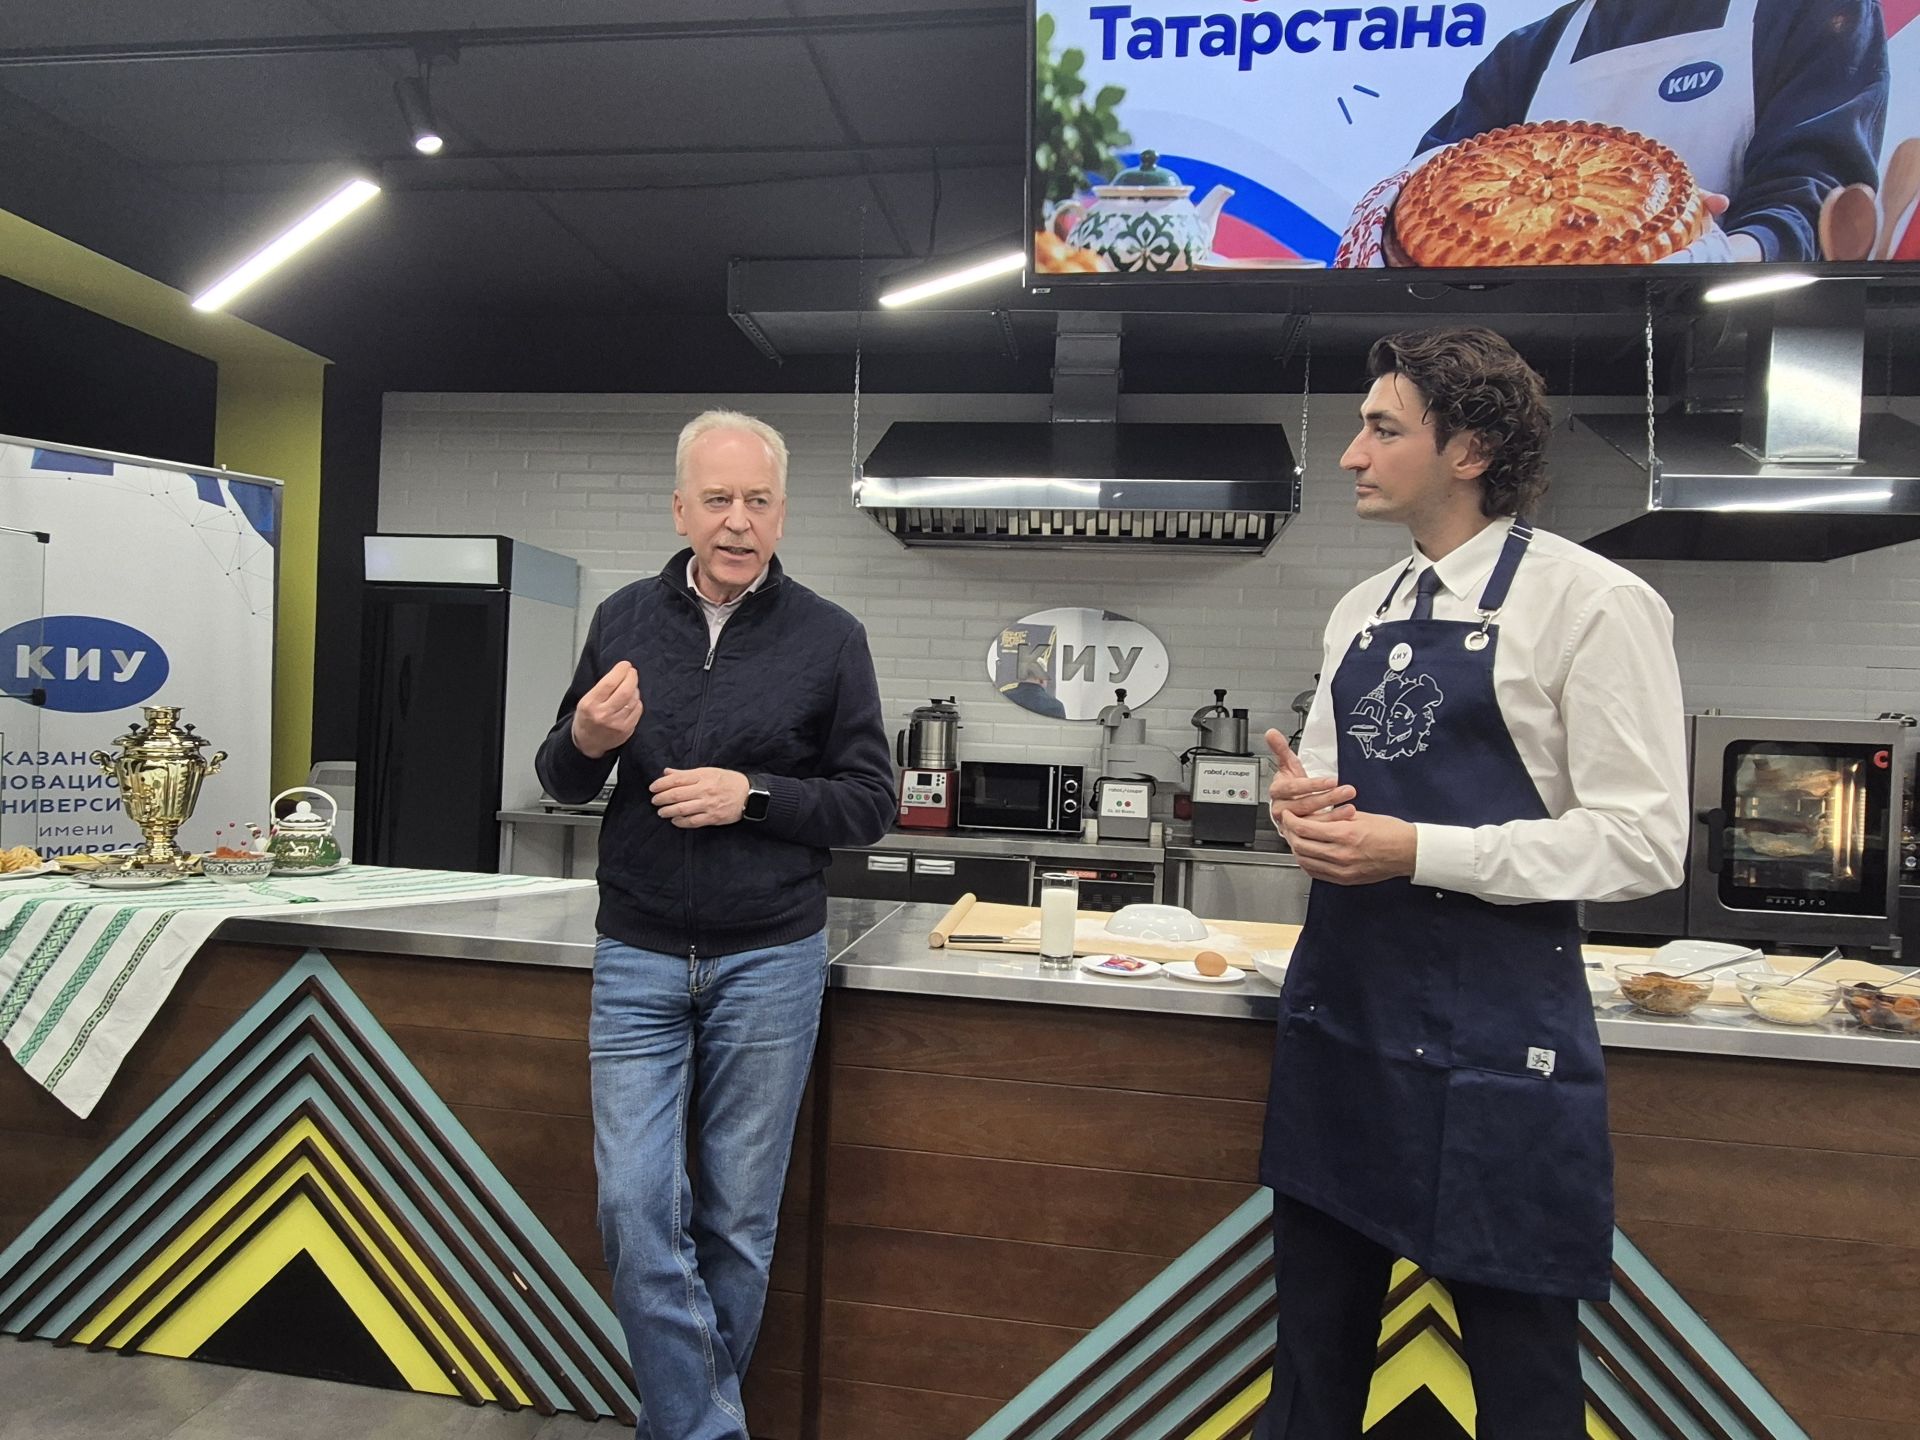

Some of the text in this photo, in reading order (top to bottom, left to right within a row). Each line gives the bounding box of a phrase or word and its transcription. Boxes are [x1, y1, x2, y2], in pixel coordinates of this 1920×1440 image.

[1089, 2, 1487, 72] Татарстана
[1667, 69, 1716, 95] КИУ
[15, 644, 147, 683] КИУ
[1016, 643, 1144, 684] КИУ
[39, 824, 114, 837] имени
